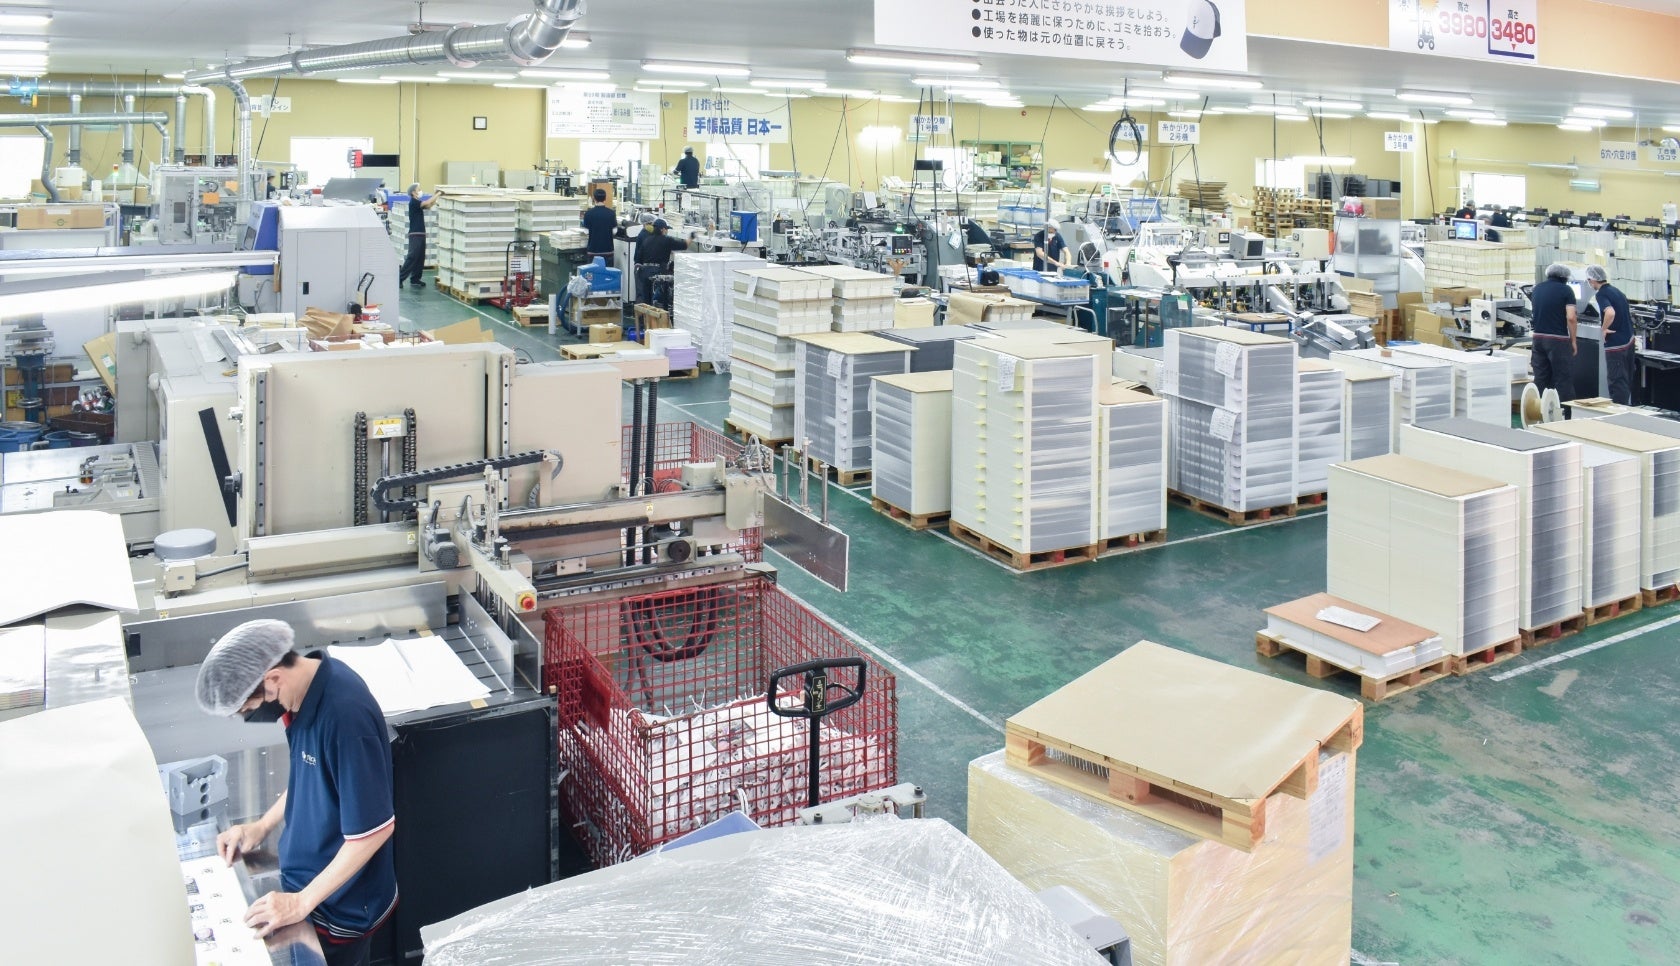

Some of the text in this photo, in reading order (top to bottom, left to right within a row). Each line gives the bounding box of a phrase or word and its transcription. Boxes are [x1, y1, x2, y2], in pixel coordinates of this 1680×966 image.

[1457, 1, 1469, 13] 高さ
[1507, 9, 1519, 20] 高さ
[983, 9, 1176, 38] 工場を綺麗に保つために、ゴミを拾おう。
[1439, 11, 1487, 38] 3980
[1491, 18, 1536, 45] 3480
[984, 26, 1132, 51] 使った物は元の位置に戻そう。
[694, 117, 782, 135] 手帳品質 日本一
[1169, 132, 1189, 142] 2号機
